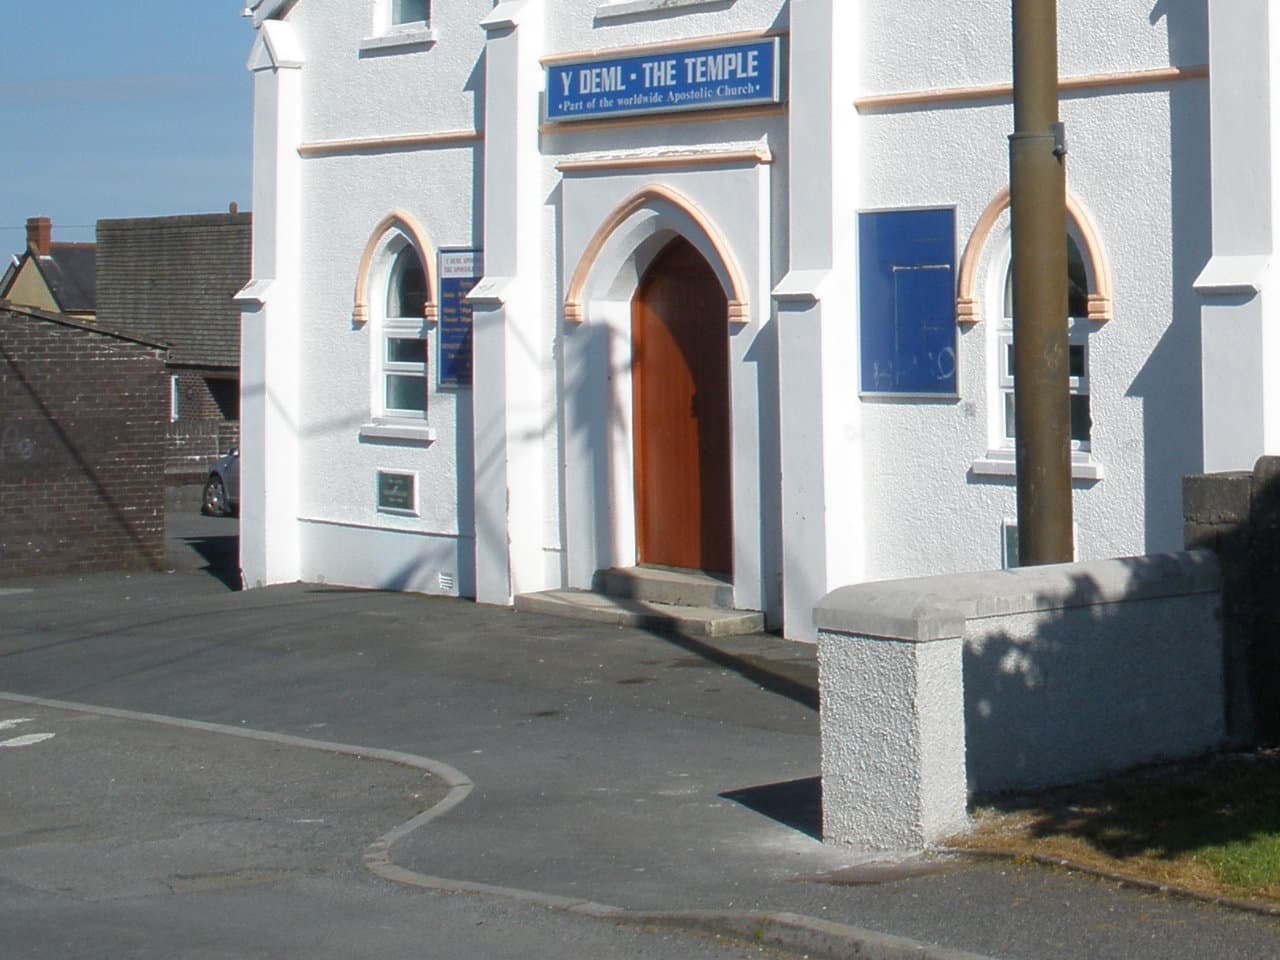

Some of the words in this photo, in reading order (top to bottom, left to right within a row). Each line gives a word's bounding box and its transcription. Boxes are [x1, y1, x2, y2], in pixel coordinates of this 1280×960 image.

[561, 71, 573, 96] Y
[579, 65, 626, 94] DEML
[642, 60, 677, 88] THE
[684, 50, 759, 84] TEMPLE
[586, 97, 597, 109] of
[599, 96, 614, 108] the
[617, 91, 664, 106] worldwide
[667, 86, 713, 103] Apostolic
